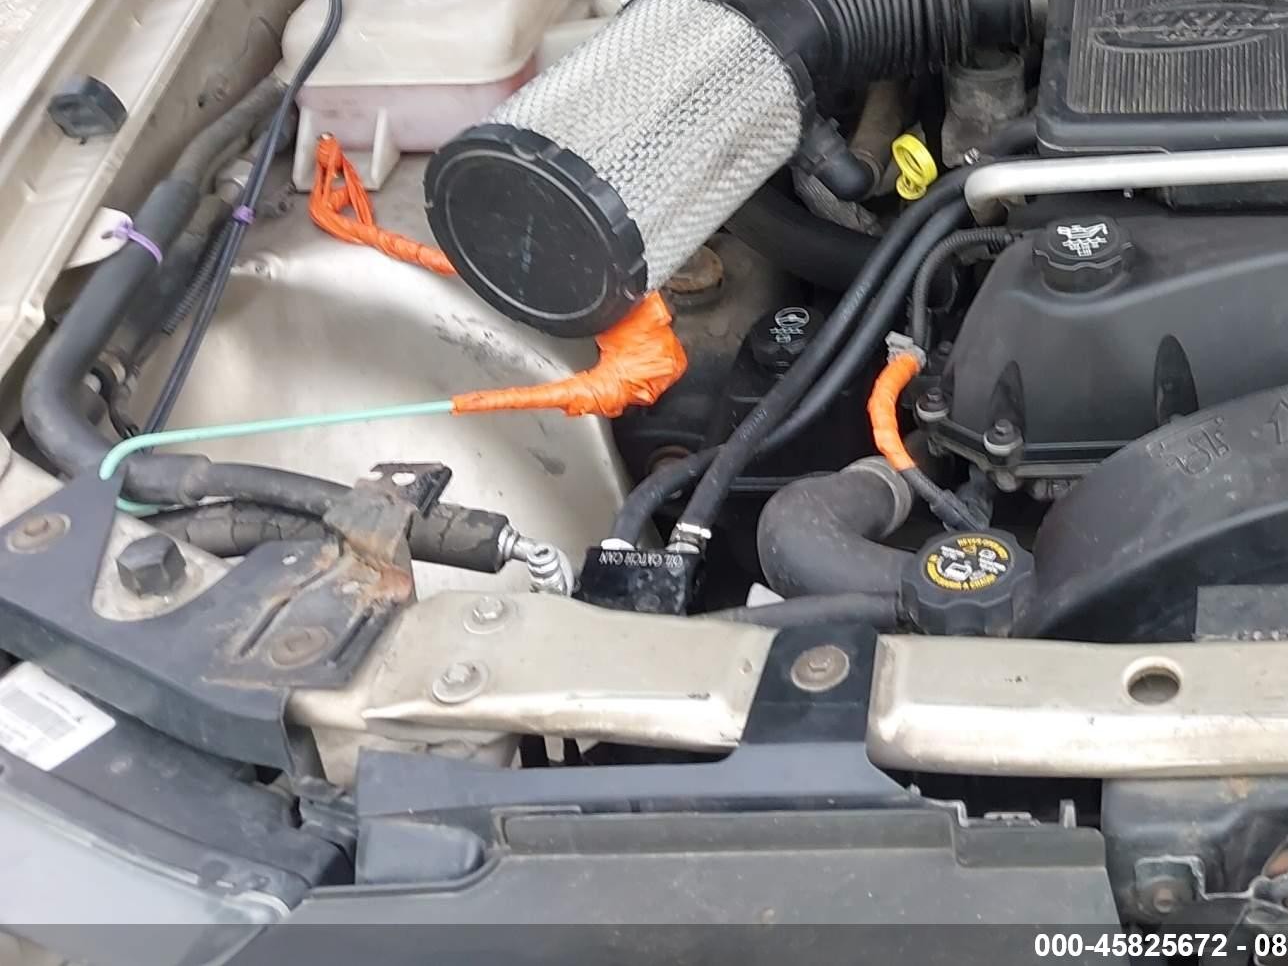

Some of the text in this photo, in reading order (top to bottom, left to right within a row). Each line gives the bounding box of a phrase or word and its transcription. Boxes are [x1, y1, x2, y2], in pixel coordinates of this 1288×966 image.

[598, 551, 684, 568] OIL CATCH CAN
